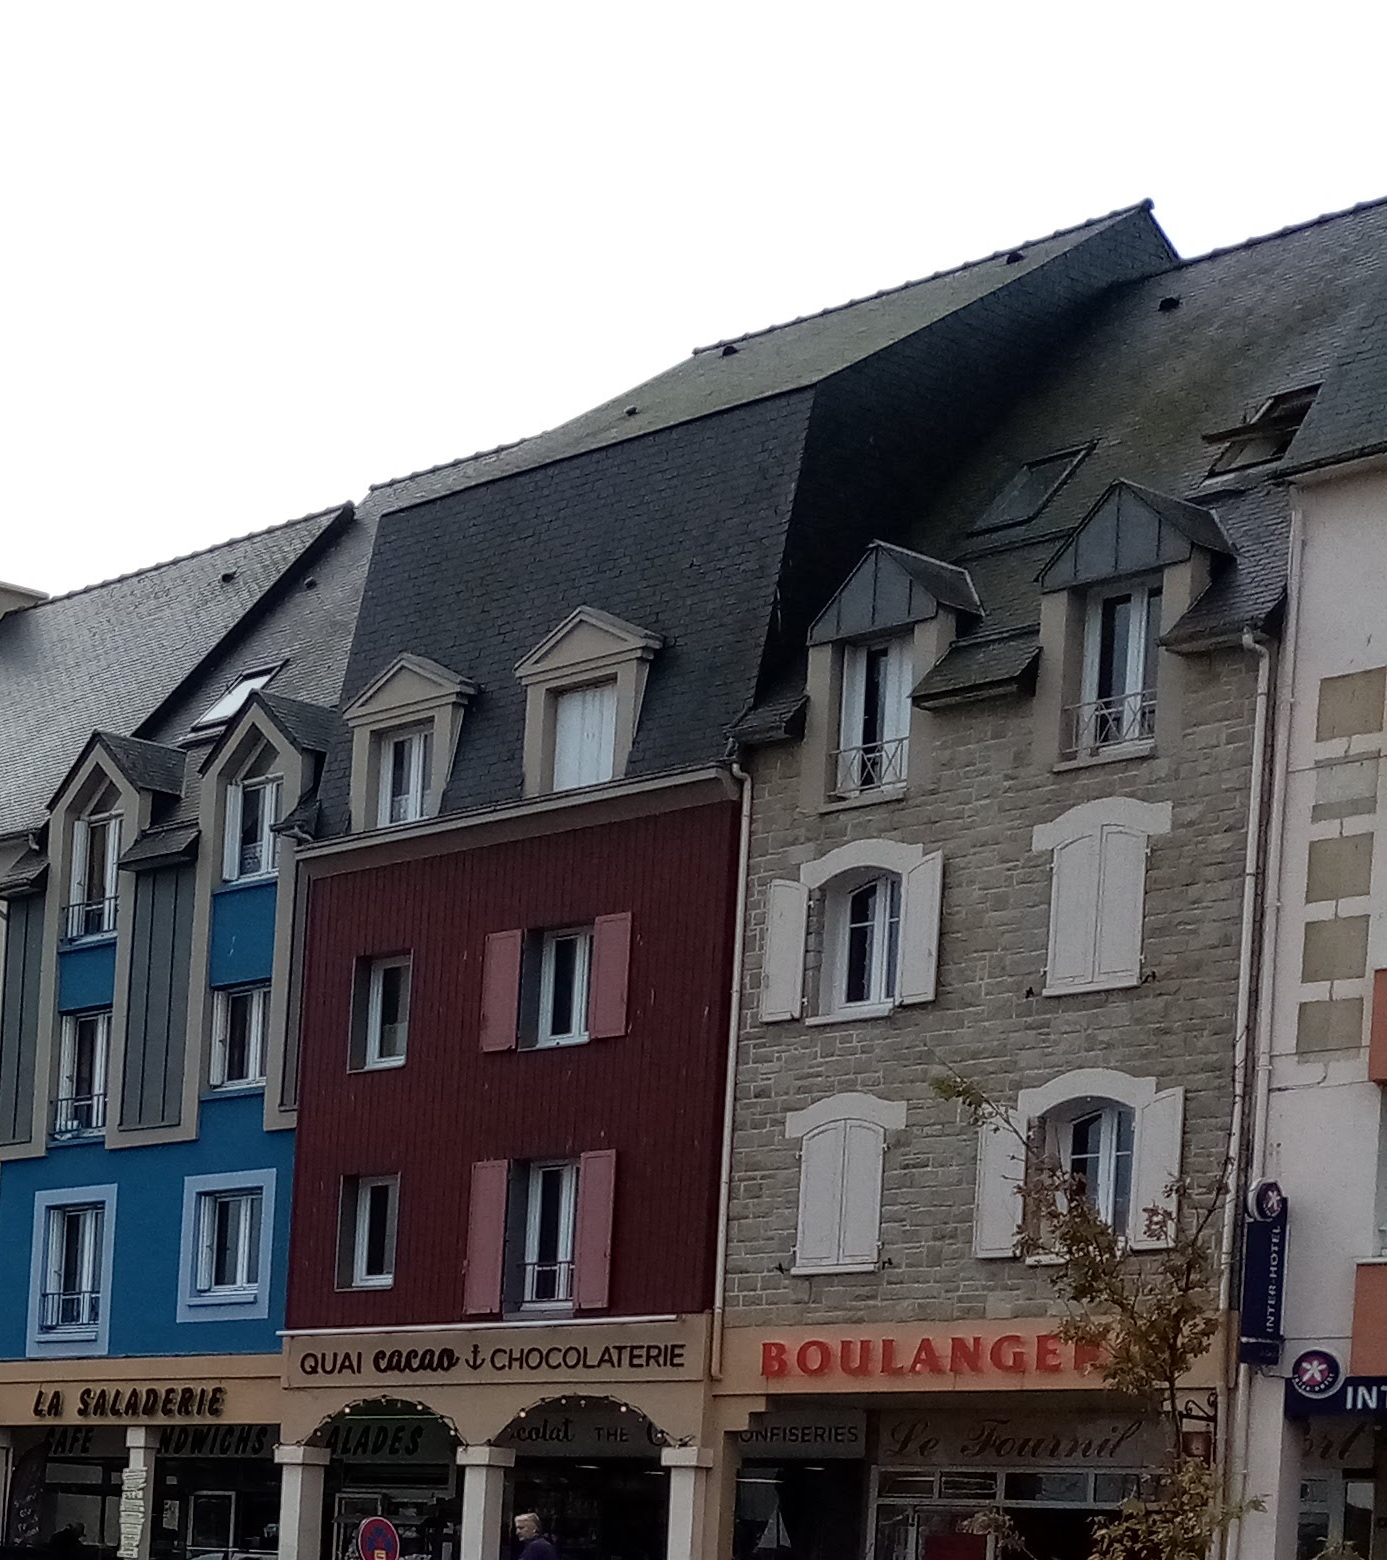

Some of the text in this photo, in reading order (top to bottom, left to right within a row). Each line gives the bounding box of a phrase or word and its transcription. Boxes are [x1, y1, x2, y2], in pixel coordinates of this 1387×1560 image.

[1265, 1225, 1282, 1334] INTER-HOTEL
[299, 1344, 687, 1375] QUAI cacao CHOCOLATERIE
[33, 1387, 225, 1417] LA SALADERIE
[159, 1425, 269, 1455] NDWICHS
[325, 1424, 424, 1456] ALADES
[595, 1427, 630, 1443] THE
[739, 1426, 858, 1443] ONFISERIES
[889, 1418, 1144, 1460] Le Fournil
